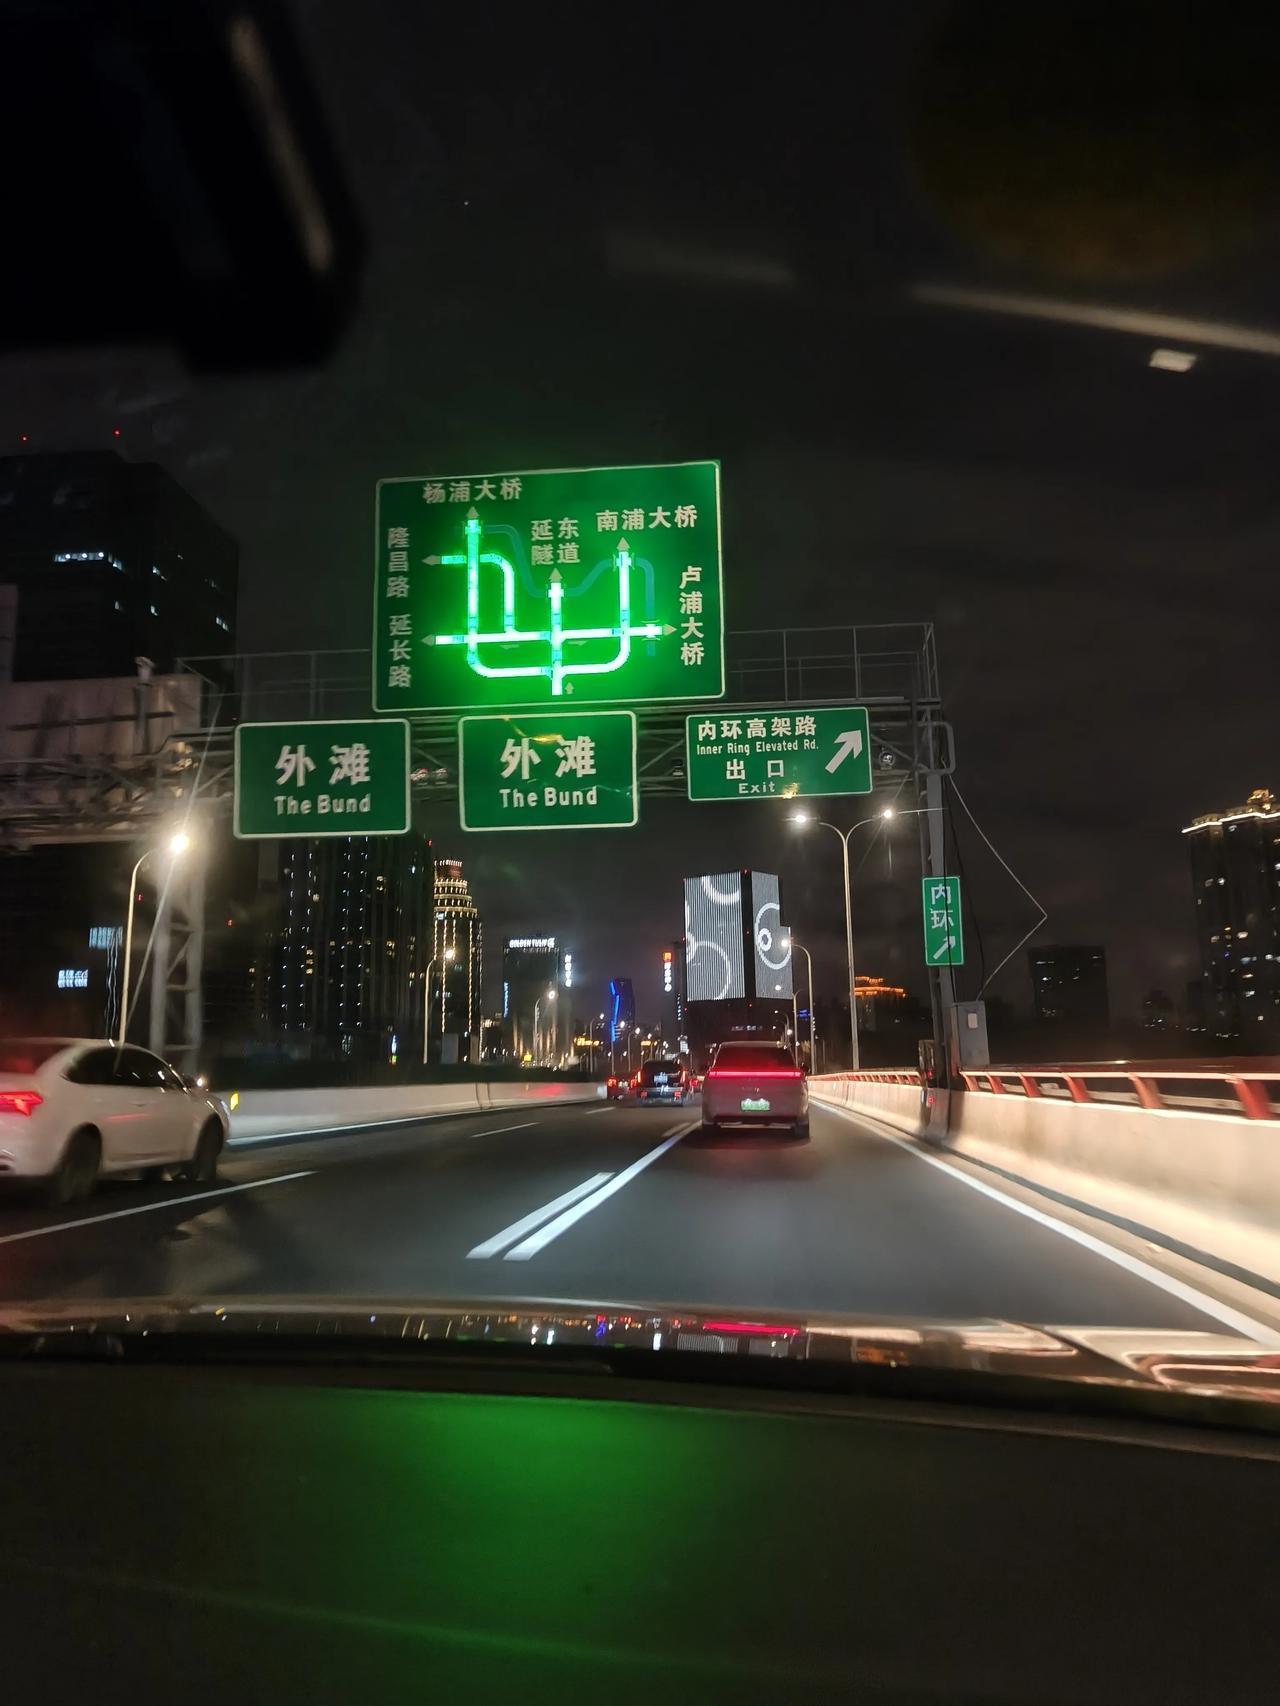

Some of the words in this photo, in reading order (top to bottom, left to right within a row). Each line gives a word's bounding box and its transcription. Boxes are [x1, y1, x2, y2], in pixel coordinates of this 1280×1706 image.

[422, 477, 522, 504] 杨浦大桥
[531, 518, 579, 541] 延东
[596, 505, 698, 532] 南浦大桥
[387, 527, 410, 598] 隆昌路
[531, 542, 580, 566] 隧道
[679, 566, 705, 665] 卢浦大桥
[388, 614, 412, 688] 延长路
[698, 715, 817, 741] 内环高架路
[500, 735, 597, 780] 外滩
[697, 744, 723, 755] Inner
[727, 742, 750, 756] Ring
[756, 740, 798, 753] Elevated
[804, 739, 819, 750] Rd.
[275, 743, 371, 787] 外滩
[726, 759, 784, 780] 出口
[499, 788, 538, 808] The
[544, 786, 597, 807] Bund
[738, 781, 775, 794] Exit
[274, 795, 312, 815] The
[317, 793, 371, 814] Bund
[930, 883, 954, 931] 内环
